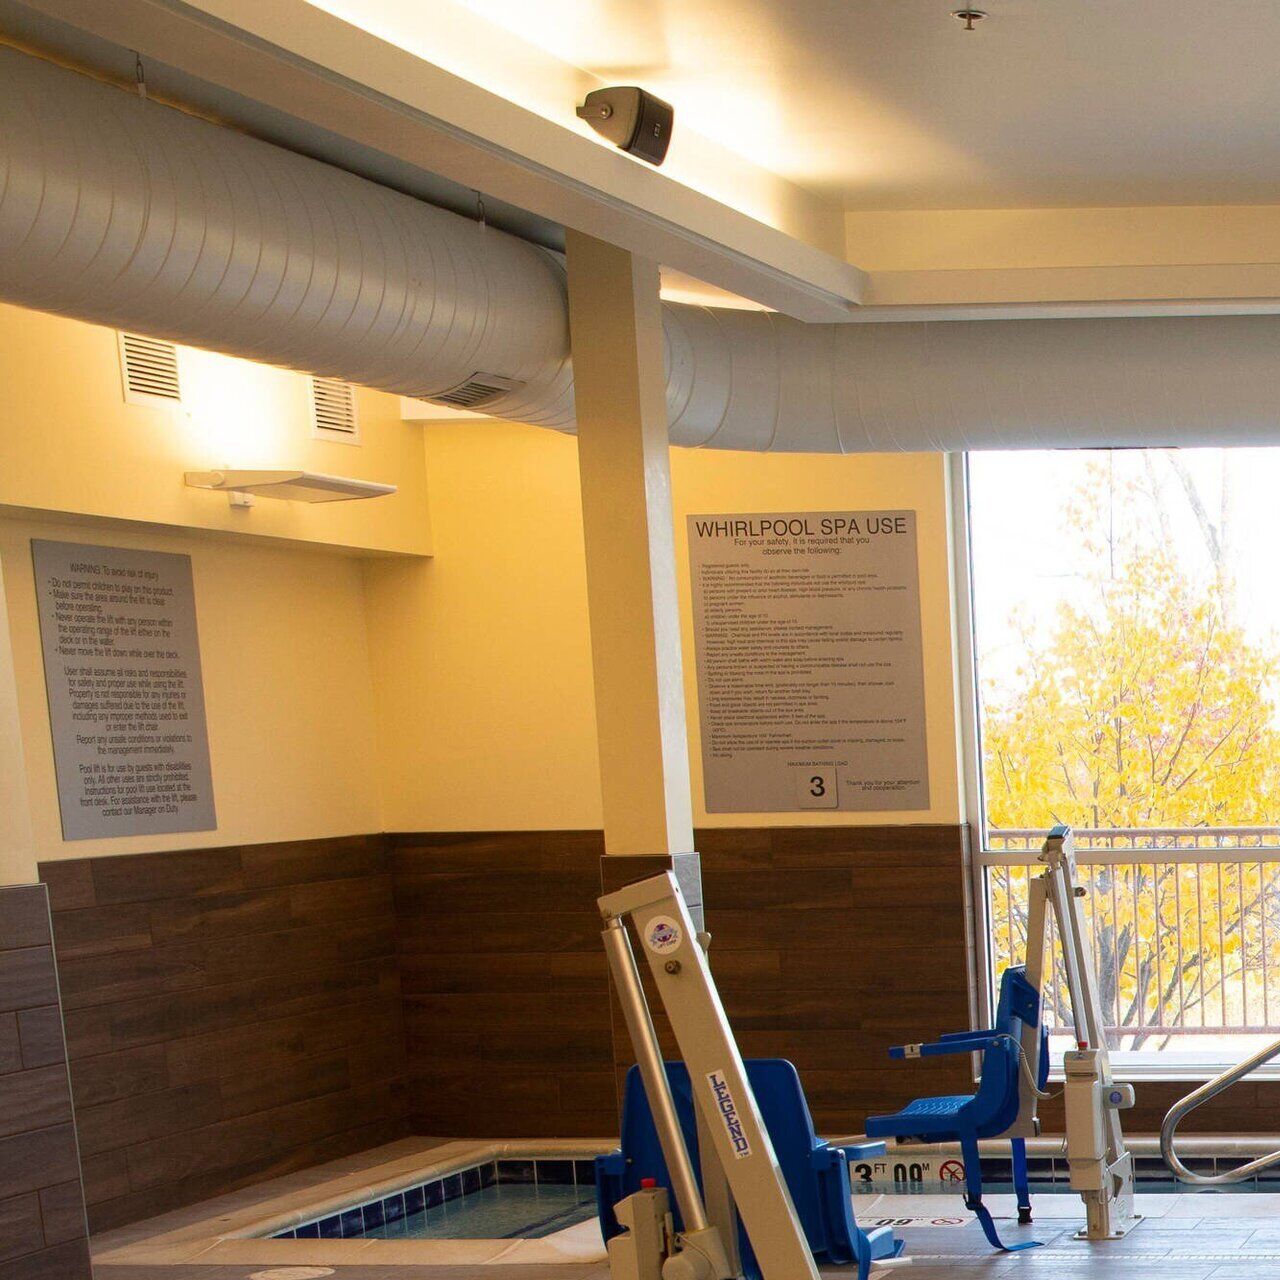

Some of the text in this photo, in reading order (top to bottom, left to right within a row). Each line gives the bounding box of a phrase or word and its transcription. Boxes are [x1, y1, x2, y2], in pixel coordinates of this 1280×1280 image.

[695, 517, 907, 537] WHIRLPOOL SPA USE
[734, 538, 747, 546] For
[749, 539, 764, 548] your
[808, 537, 838, 545] required
[840, 536, 854, 544] that
[856, 537, 870, 545] you
[762, 547, 792, 555] observe
[810, 776, 826, 797] 3
[710, 1075, 749, 1153] LEGEND
[874, 1163, 887, 1174] FT
